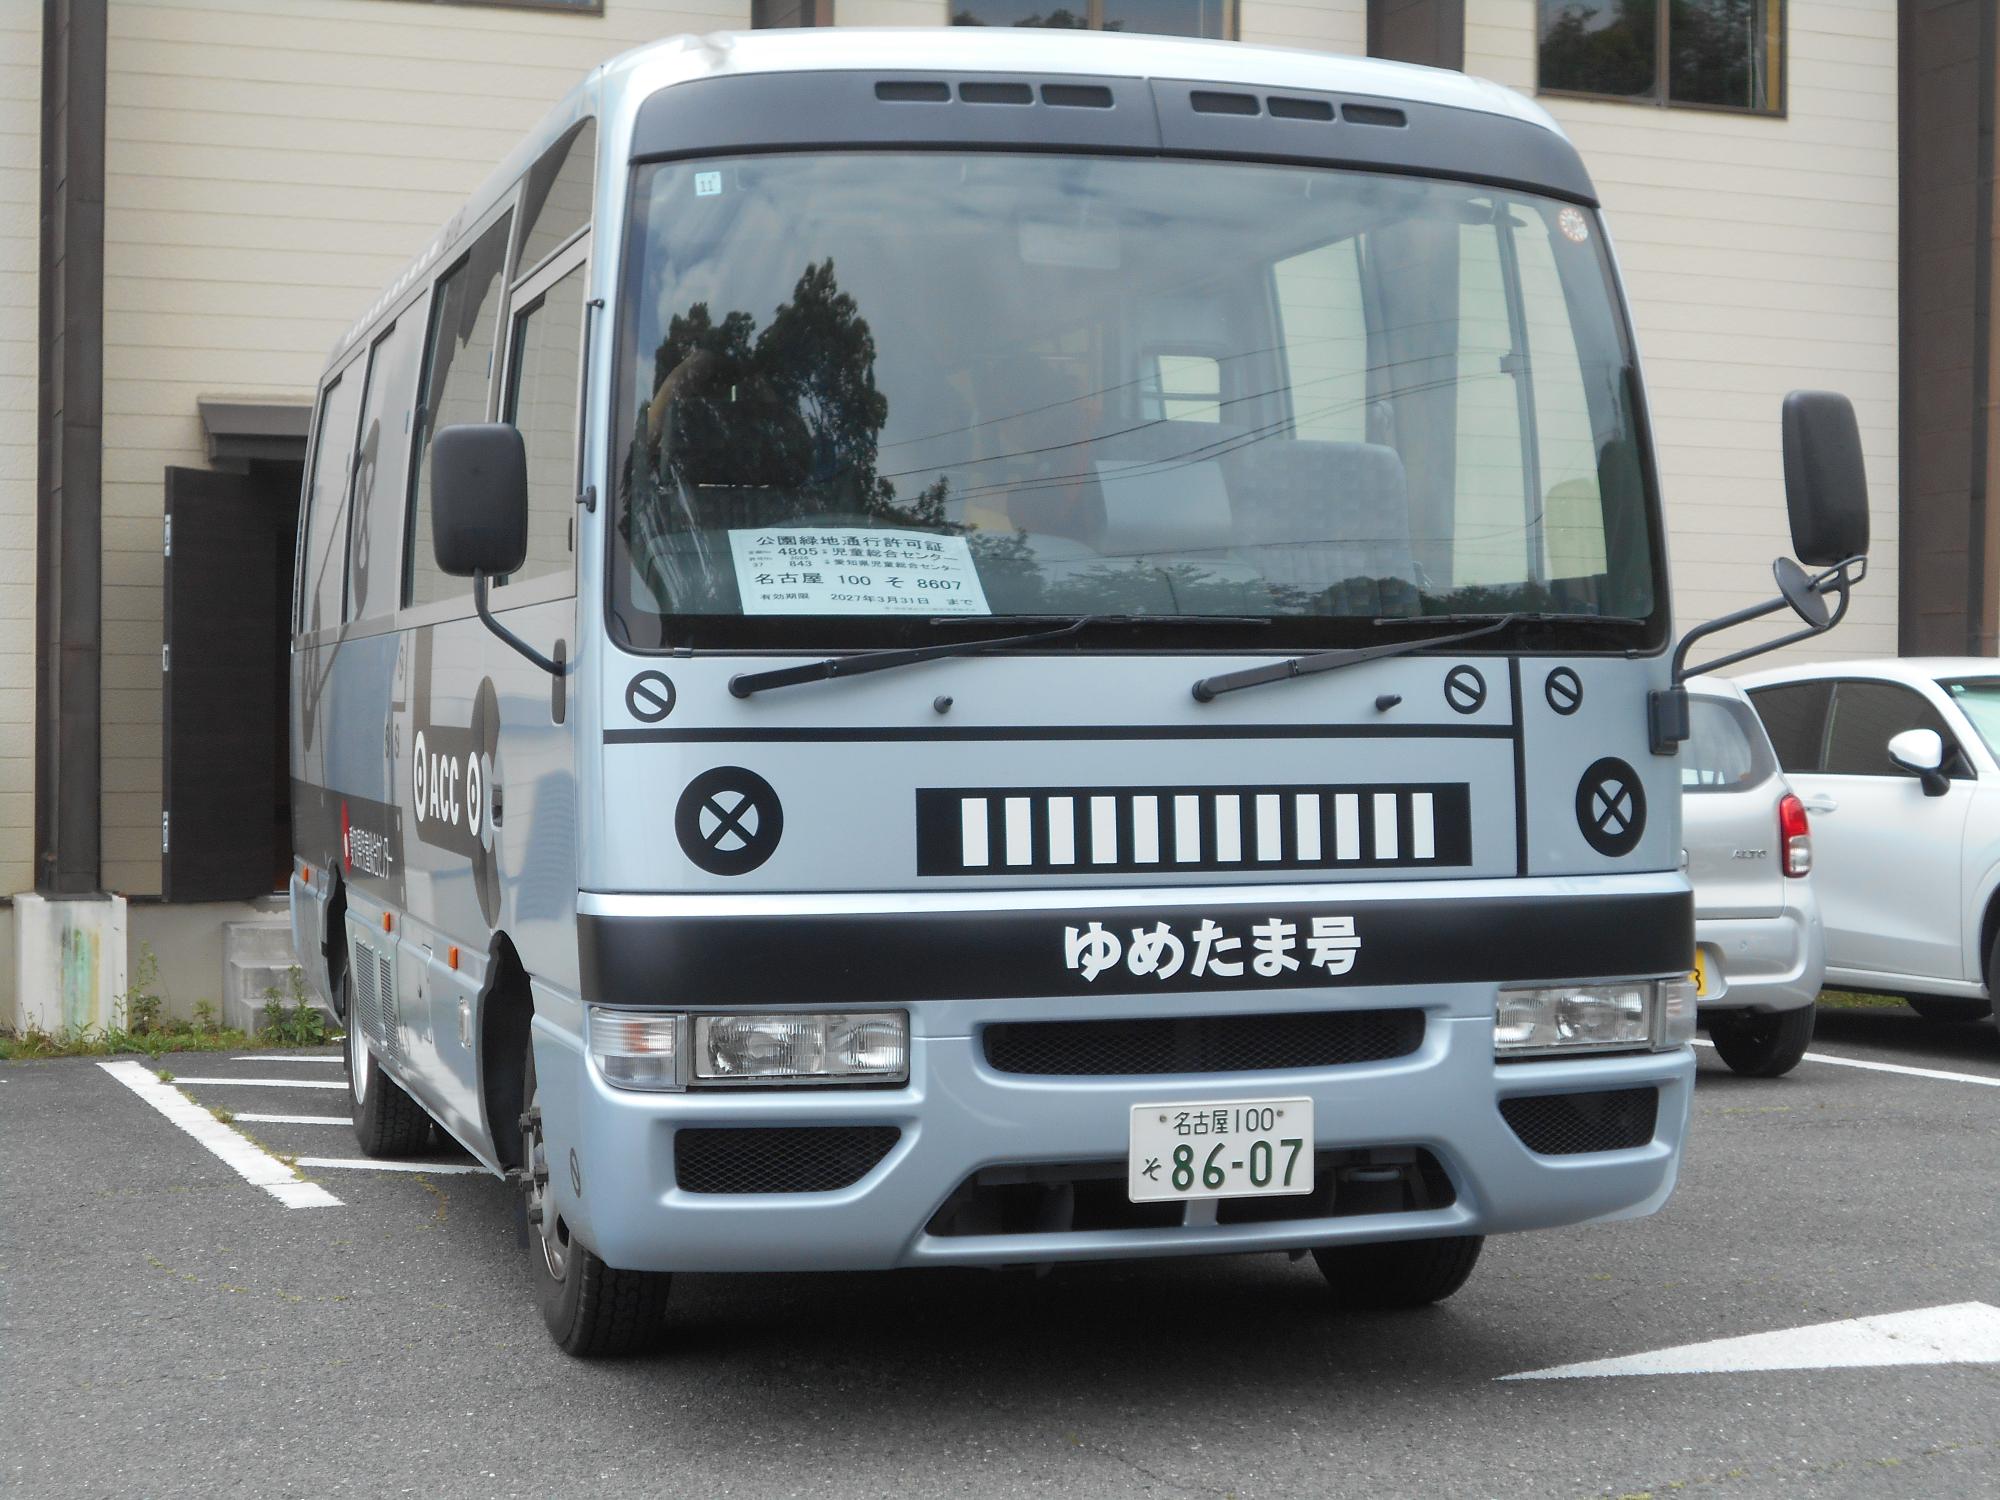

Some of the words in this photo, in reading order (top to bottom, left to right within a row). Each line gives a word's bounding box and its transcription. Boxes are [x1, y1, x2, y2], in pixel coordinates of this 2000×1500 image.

[756, 535, 945, 552] 公園緑地通行許可証
[778, 547, 818, 556] 4805
[755, 572, 824, 585] 名古屋
[838, 575, 871, 586] 100
[886, 576, 904, 589] そ
[917, 578, 962, 591] 8607
[760, 592, 810, 601] 有効期限
[830, 593, 930, 606] 2027年3月31日
[430, 753, 459, 825] ACC
[1065, 916, 1361, 982] ゆめたま号
[1171, 1138, 1303, 1192] 86-07
